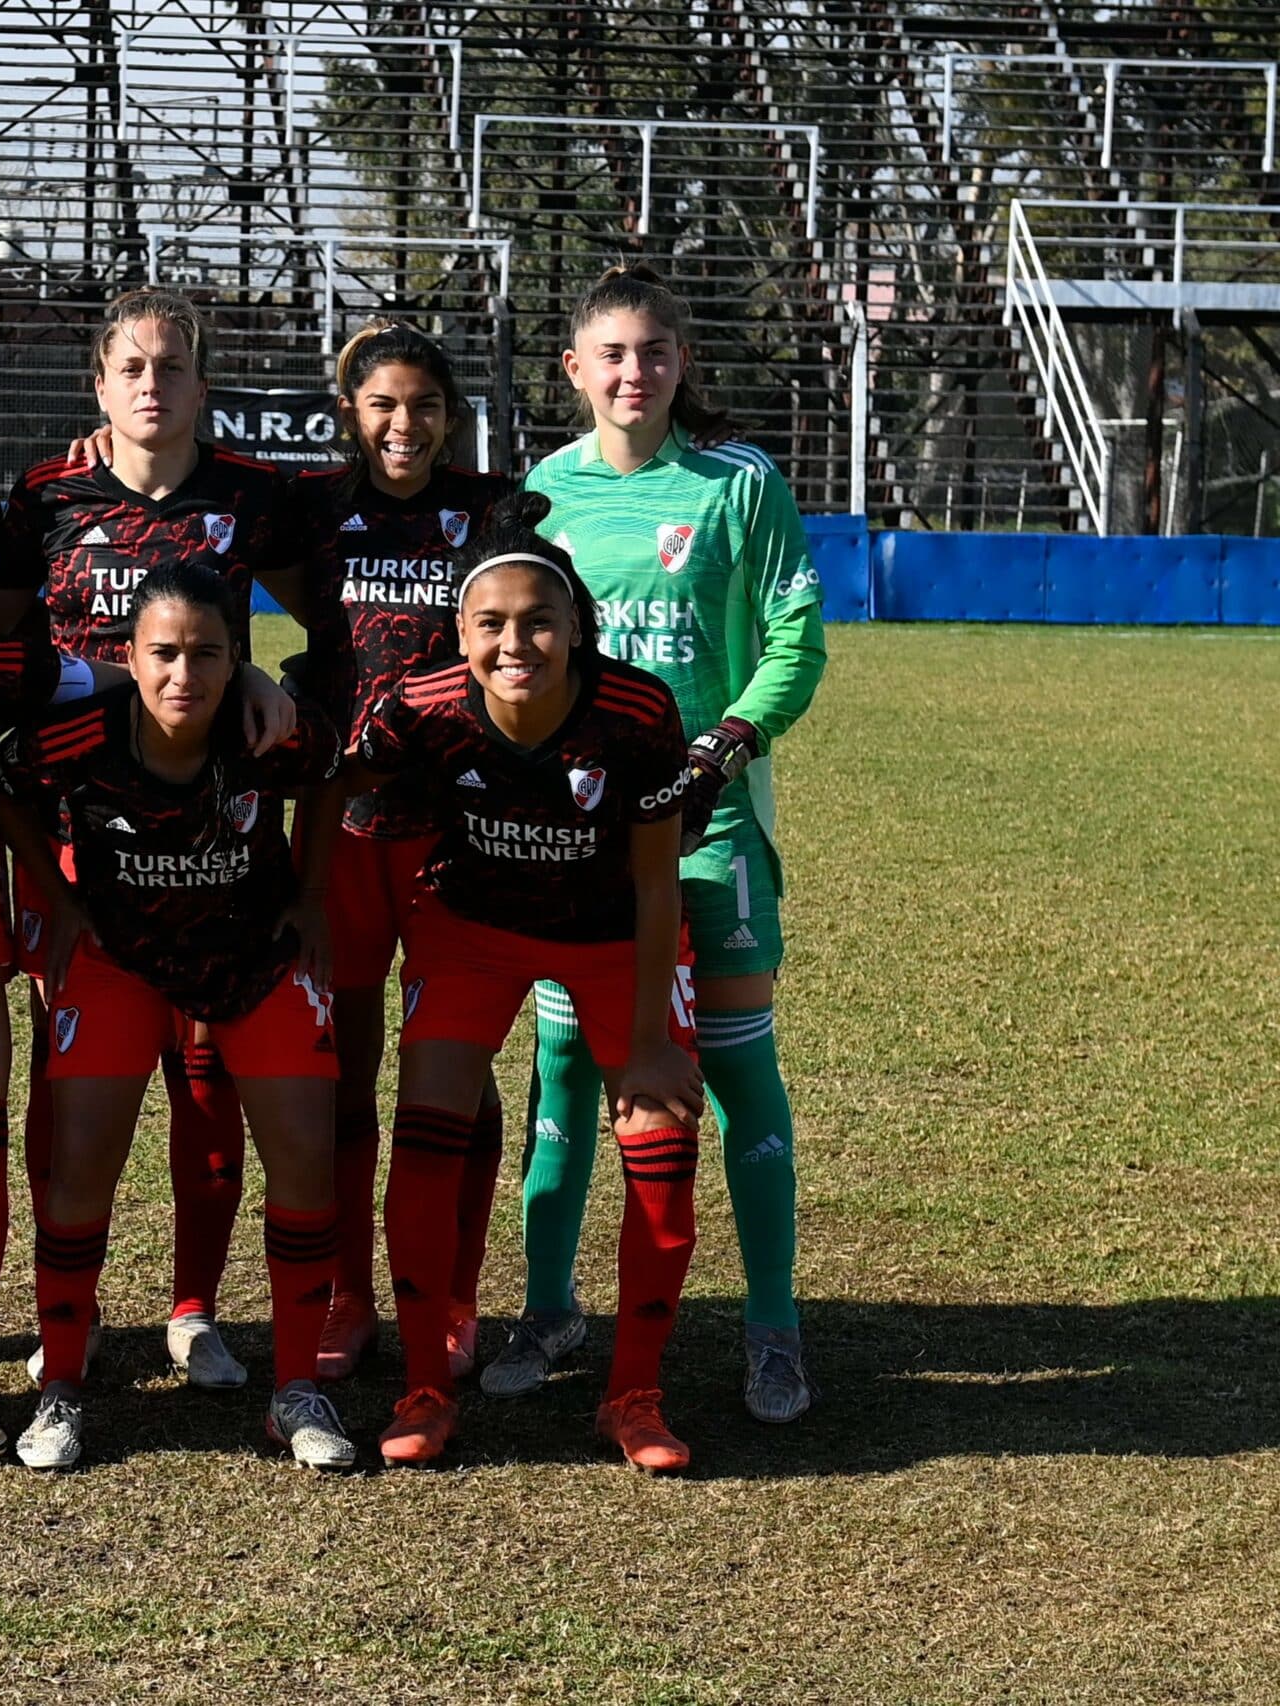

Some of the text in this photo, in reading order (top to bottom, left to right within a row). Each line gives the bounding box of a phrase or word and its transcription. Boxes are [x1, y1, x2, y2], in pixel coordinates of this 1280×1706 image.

[256, 450, 329, 462] ELEMENTOS
[345, 557, 456, 582] TURKISH
[456, 778, 487, 790] adidas
[464, 811, 596, 845] TURKISH
[114, 845, 250, 872] TURKISH
[468, 834, 597, 861] AIRLINES
[116, 864, 250, 887] AIRLINES
[728, 855, 750, 919] 1
[723, 939, 759, 949] adidas
